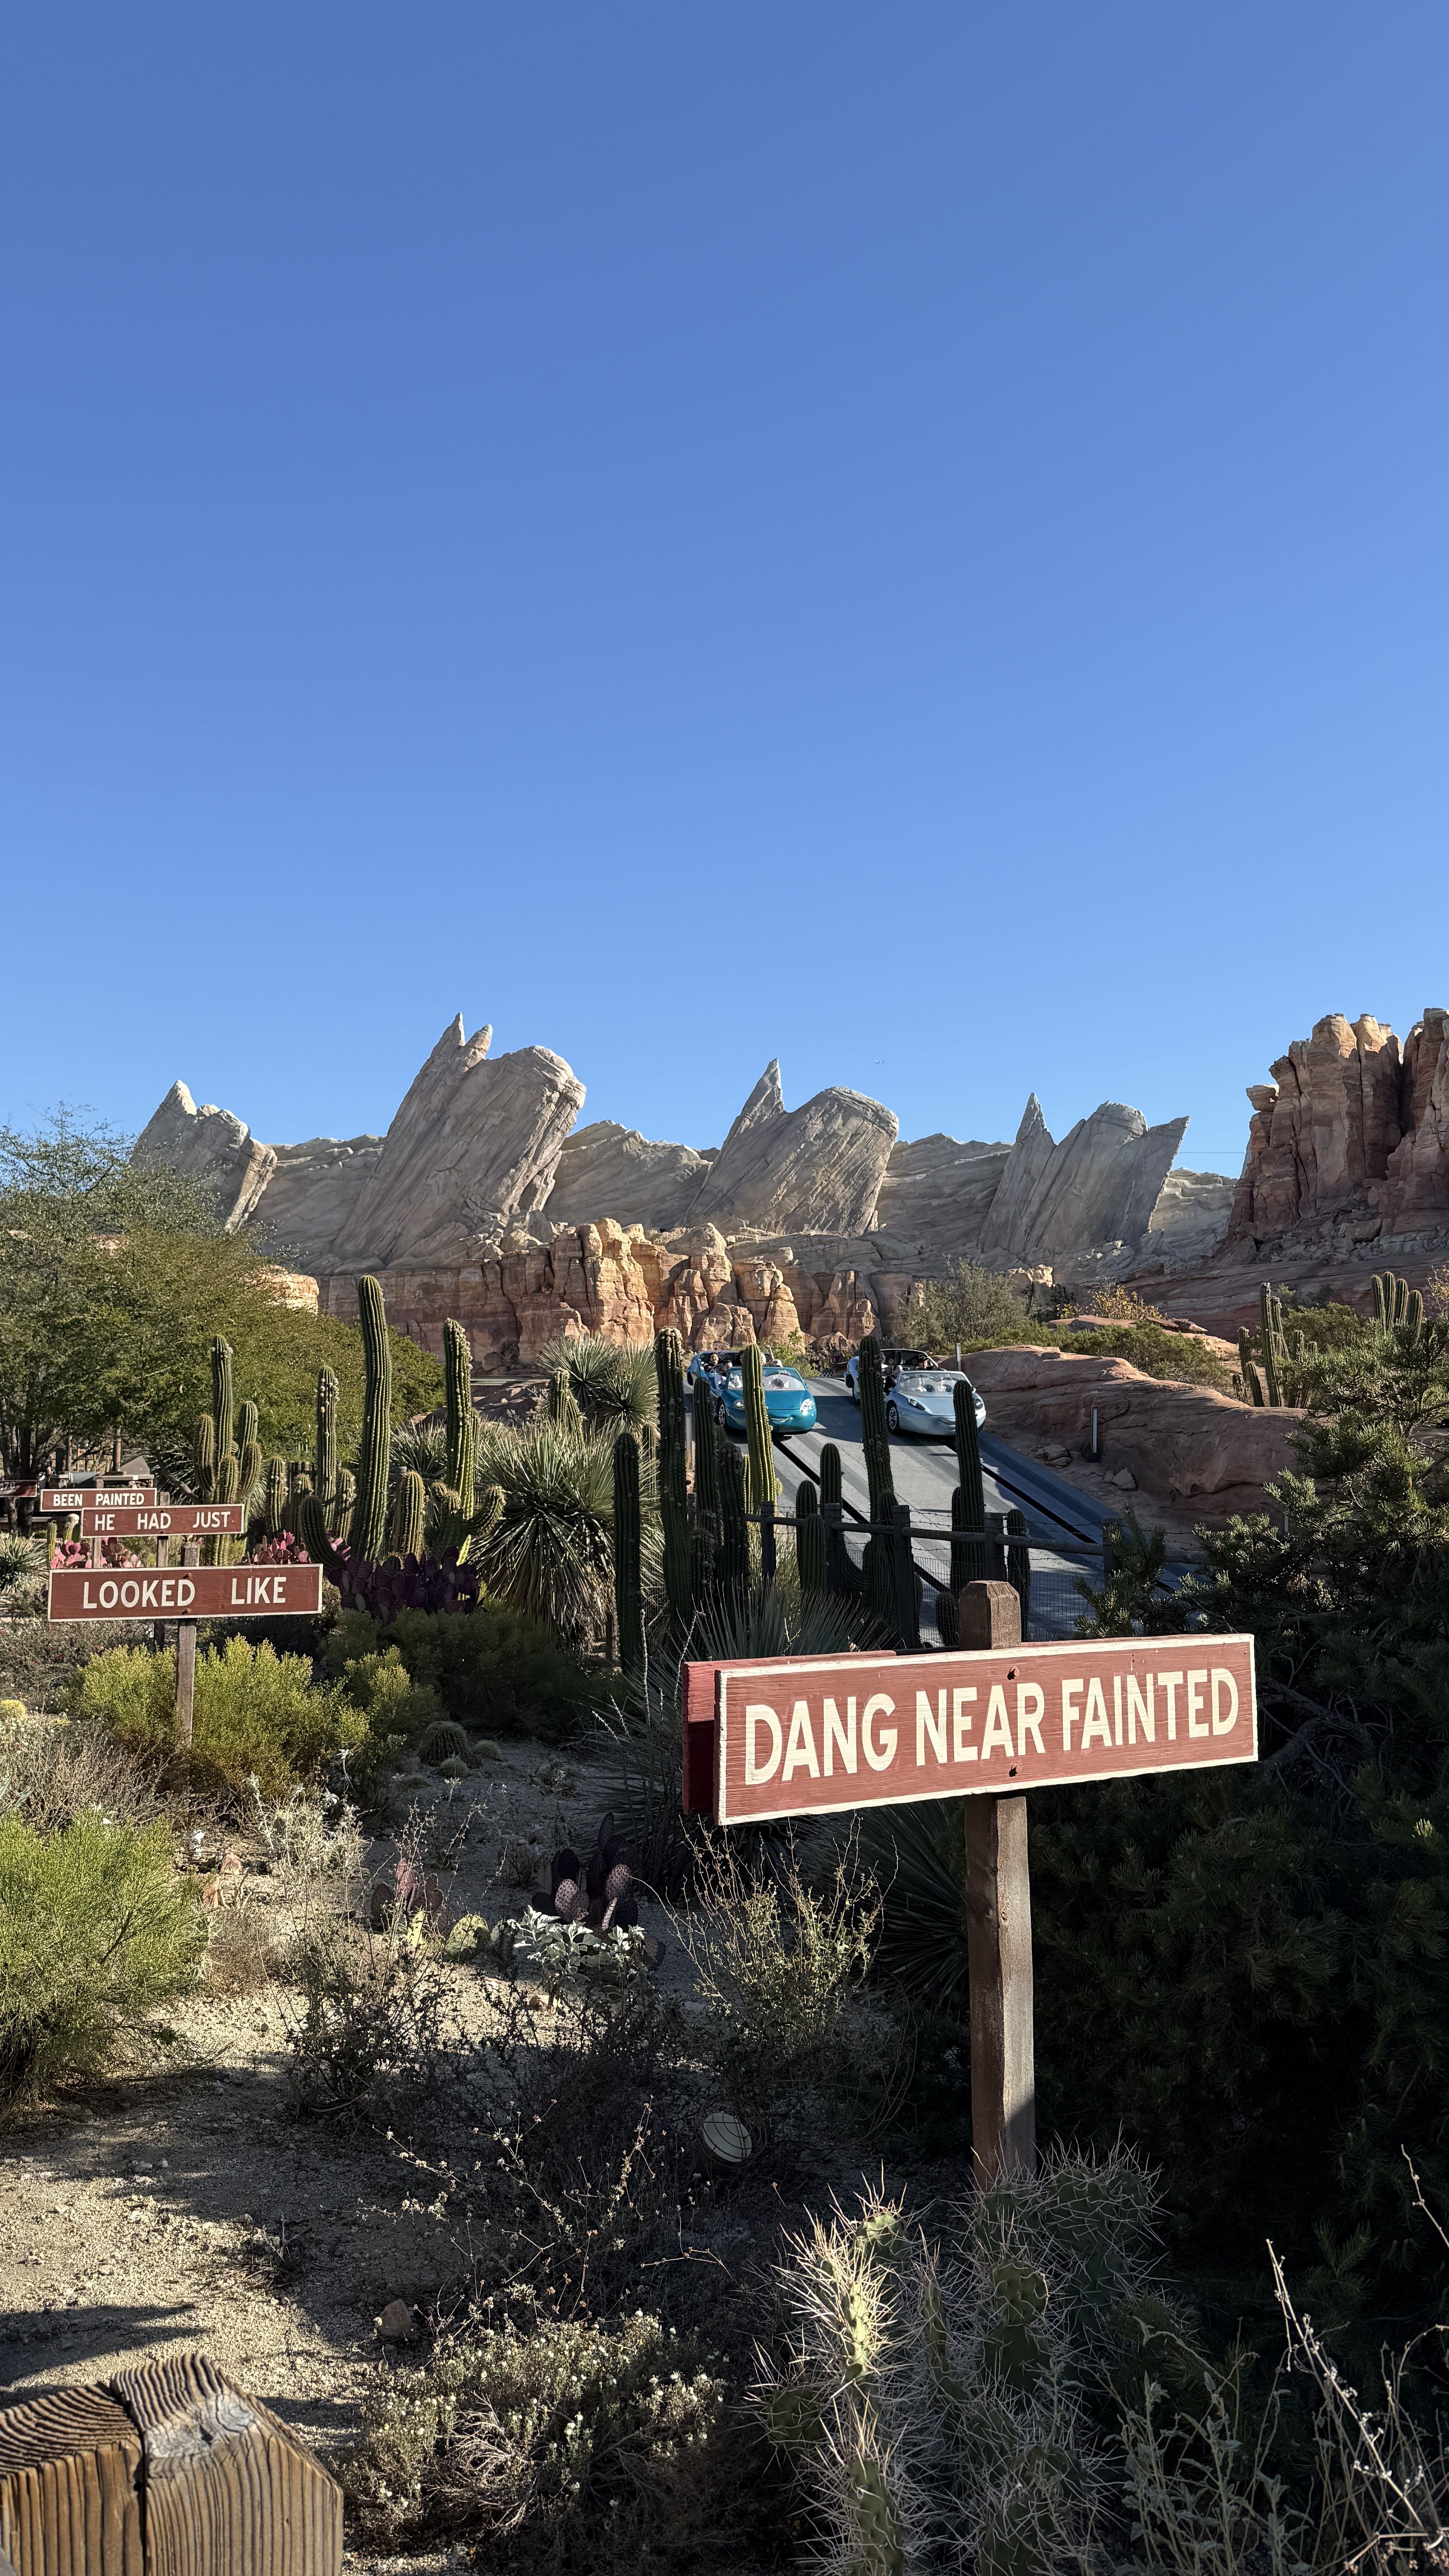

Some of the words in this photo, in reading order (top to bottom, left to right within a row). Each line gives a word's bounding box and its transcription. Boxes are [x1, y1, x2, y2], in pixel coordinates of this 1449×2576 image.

[53, 1494, 83, 1507] BEEN
[96, 1493, 145, 1506] PAINTED
[95, 1514, 115, 1531] HE
[137, 1513, 171, 1530] HAD
[193, 1511, 231, 1528] JUST
[83, 1579, 195, 1609] LOOKED
[231, 1577, 286, 1605] LIKE
[745, 1693, 898, 1785] DANG
[915, 1682, 1046, 1766] NEAR
[1062, 1668, 1239, 1751] FAINTED
